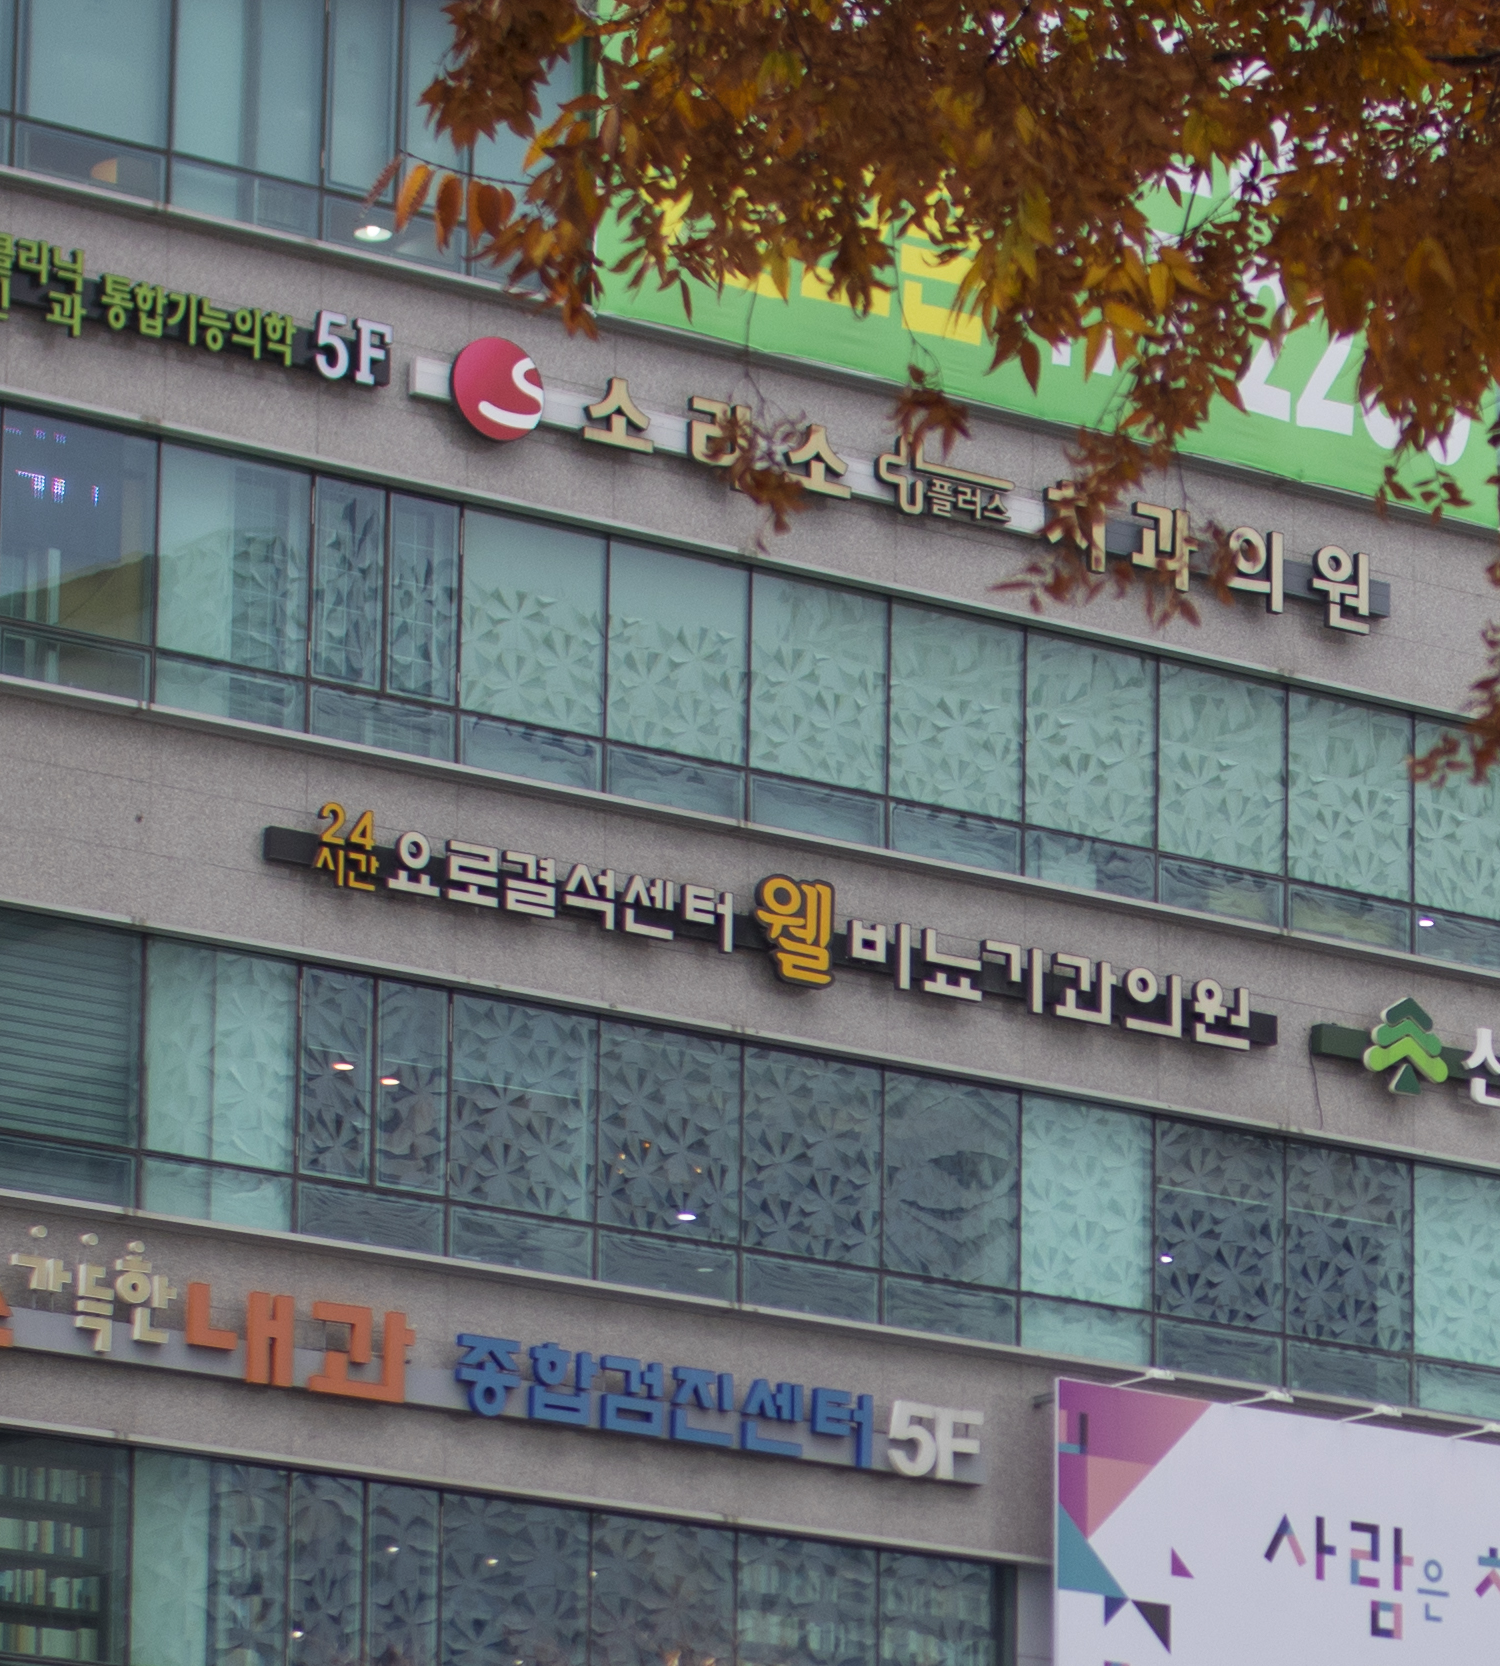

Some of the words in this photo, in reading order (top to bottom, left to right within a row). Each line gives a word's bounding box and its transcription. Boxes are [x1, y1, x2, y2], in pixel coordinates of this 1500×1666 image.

[101, 272, 297, 368] 통합기능의학
[313, 309, 395, 386] 5F
[926, 477, 1013, 525] 플러스
[315, 846, 380, 892] 시간
[318, 801, 375, 851] 24
[386, 830, 735, 954] 요로결석센터
[11, 1236, 177, 1353] 가득한
[185, 1281, 416, 1403] 내과
[453, 1330, 876, 1474] 종합검진센터
[887, 1399, 986, 1482] 5F
[1264, 1513, 1451, 1642] 사람은
